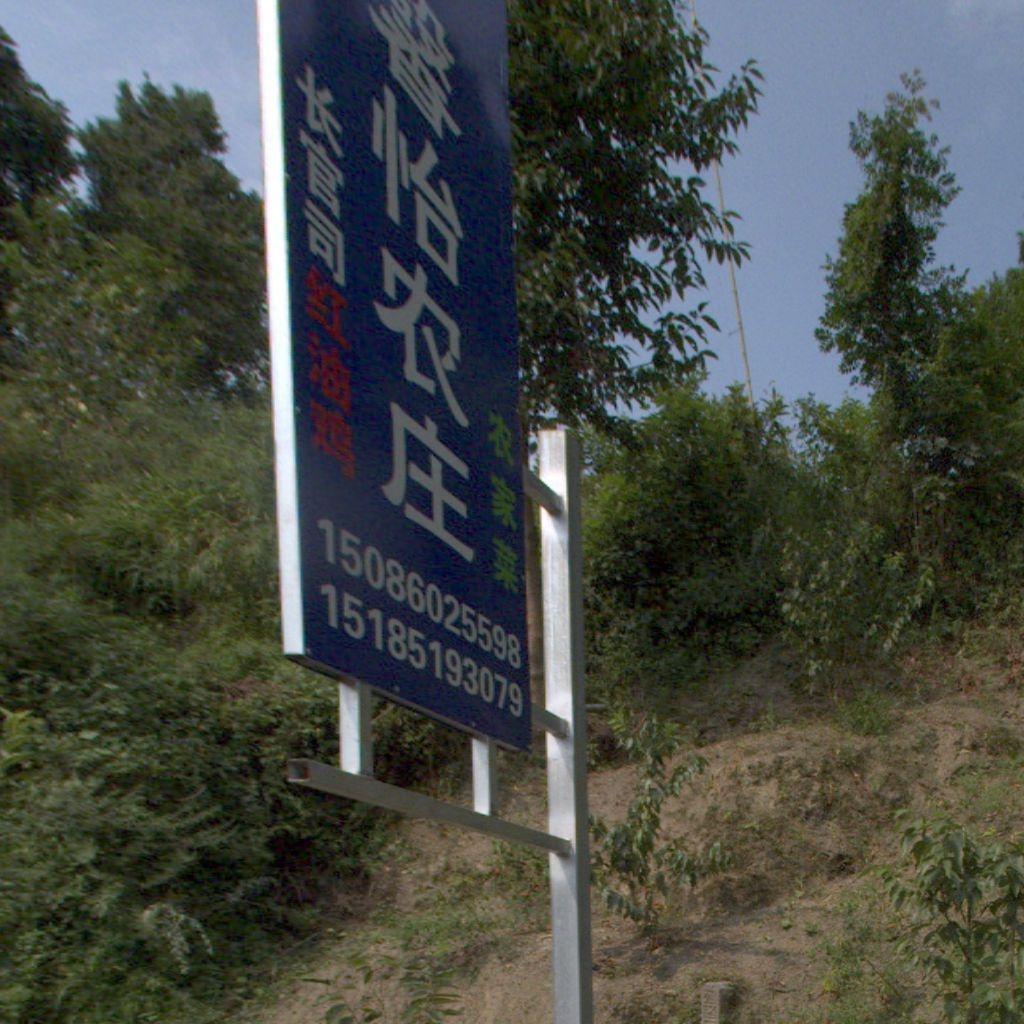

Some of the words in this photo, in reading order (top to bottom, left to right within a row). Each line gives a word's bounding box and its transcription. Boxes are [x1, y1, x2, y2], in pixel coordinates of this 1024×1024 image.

[488, 410, 519, 592] 农家菜
[317, 518, 522, 669] 15086025598
[320, 584, 524, 718] 15185193079
